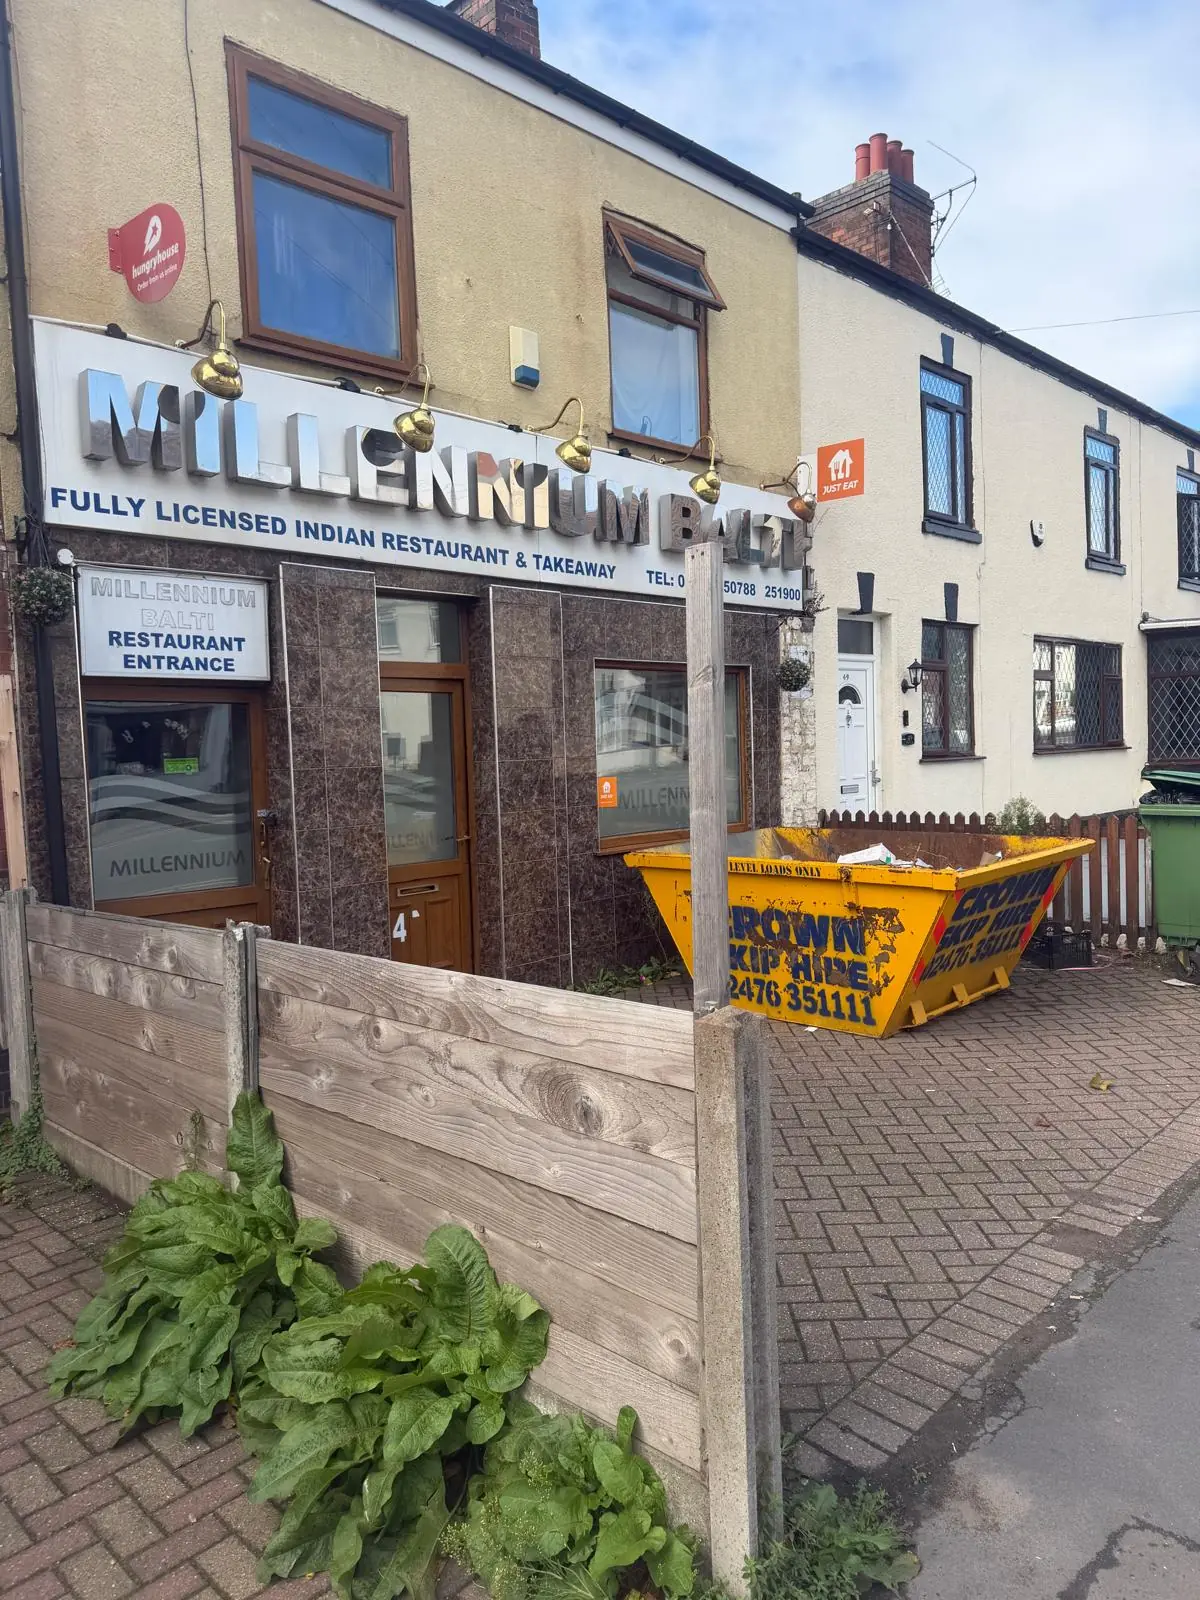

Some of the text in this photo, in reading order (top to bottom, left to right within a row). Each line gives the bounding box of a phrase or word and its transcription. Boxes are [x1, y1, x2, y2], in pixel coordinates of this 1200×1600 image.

[132, 243, 179, 279] hungryhouse
[137, 281, 149, 291] Order
[79, 368, 805, 571] MILLENNIUM BALTI
[822, 480, 859, 495] JUST EAT
[51, 487, 146, 518] FULLY
[155, 500, 287, 535] LICENSED
[295, 520, 375, 548] INDIAN
[381, 532, 510, 566] RESTAURANT
[515, 551, 527, 569] &
[532, 554, 617, 580] TAKEAWAY
[646, 570, 674, 586] TEL:
[765, 585, 801, 600] 251900
[90, 576, 256, 608] MILLENNIUM
[141, 608, 215, 631] BALTI
[108, 630, 246, 652] RESTAURANT
[123, 653, 235, 672] ENTRANCE
[619, 785, 689, 809] MILLENN
[110, 849, 245, 877] MILLENNIUM
[729, 861, 822, 878] LEVEL LOADS ONLY
[951, 863, 1061, 921] CROWN
[728, 905, 866, 956] ROWN
[939, 900, 1042, 950] SKIP HIRE
[729, 944, 780, 975] KIP
[728, 974, 877, 1026] 2476 351111
